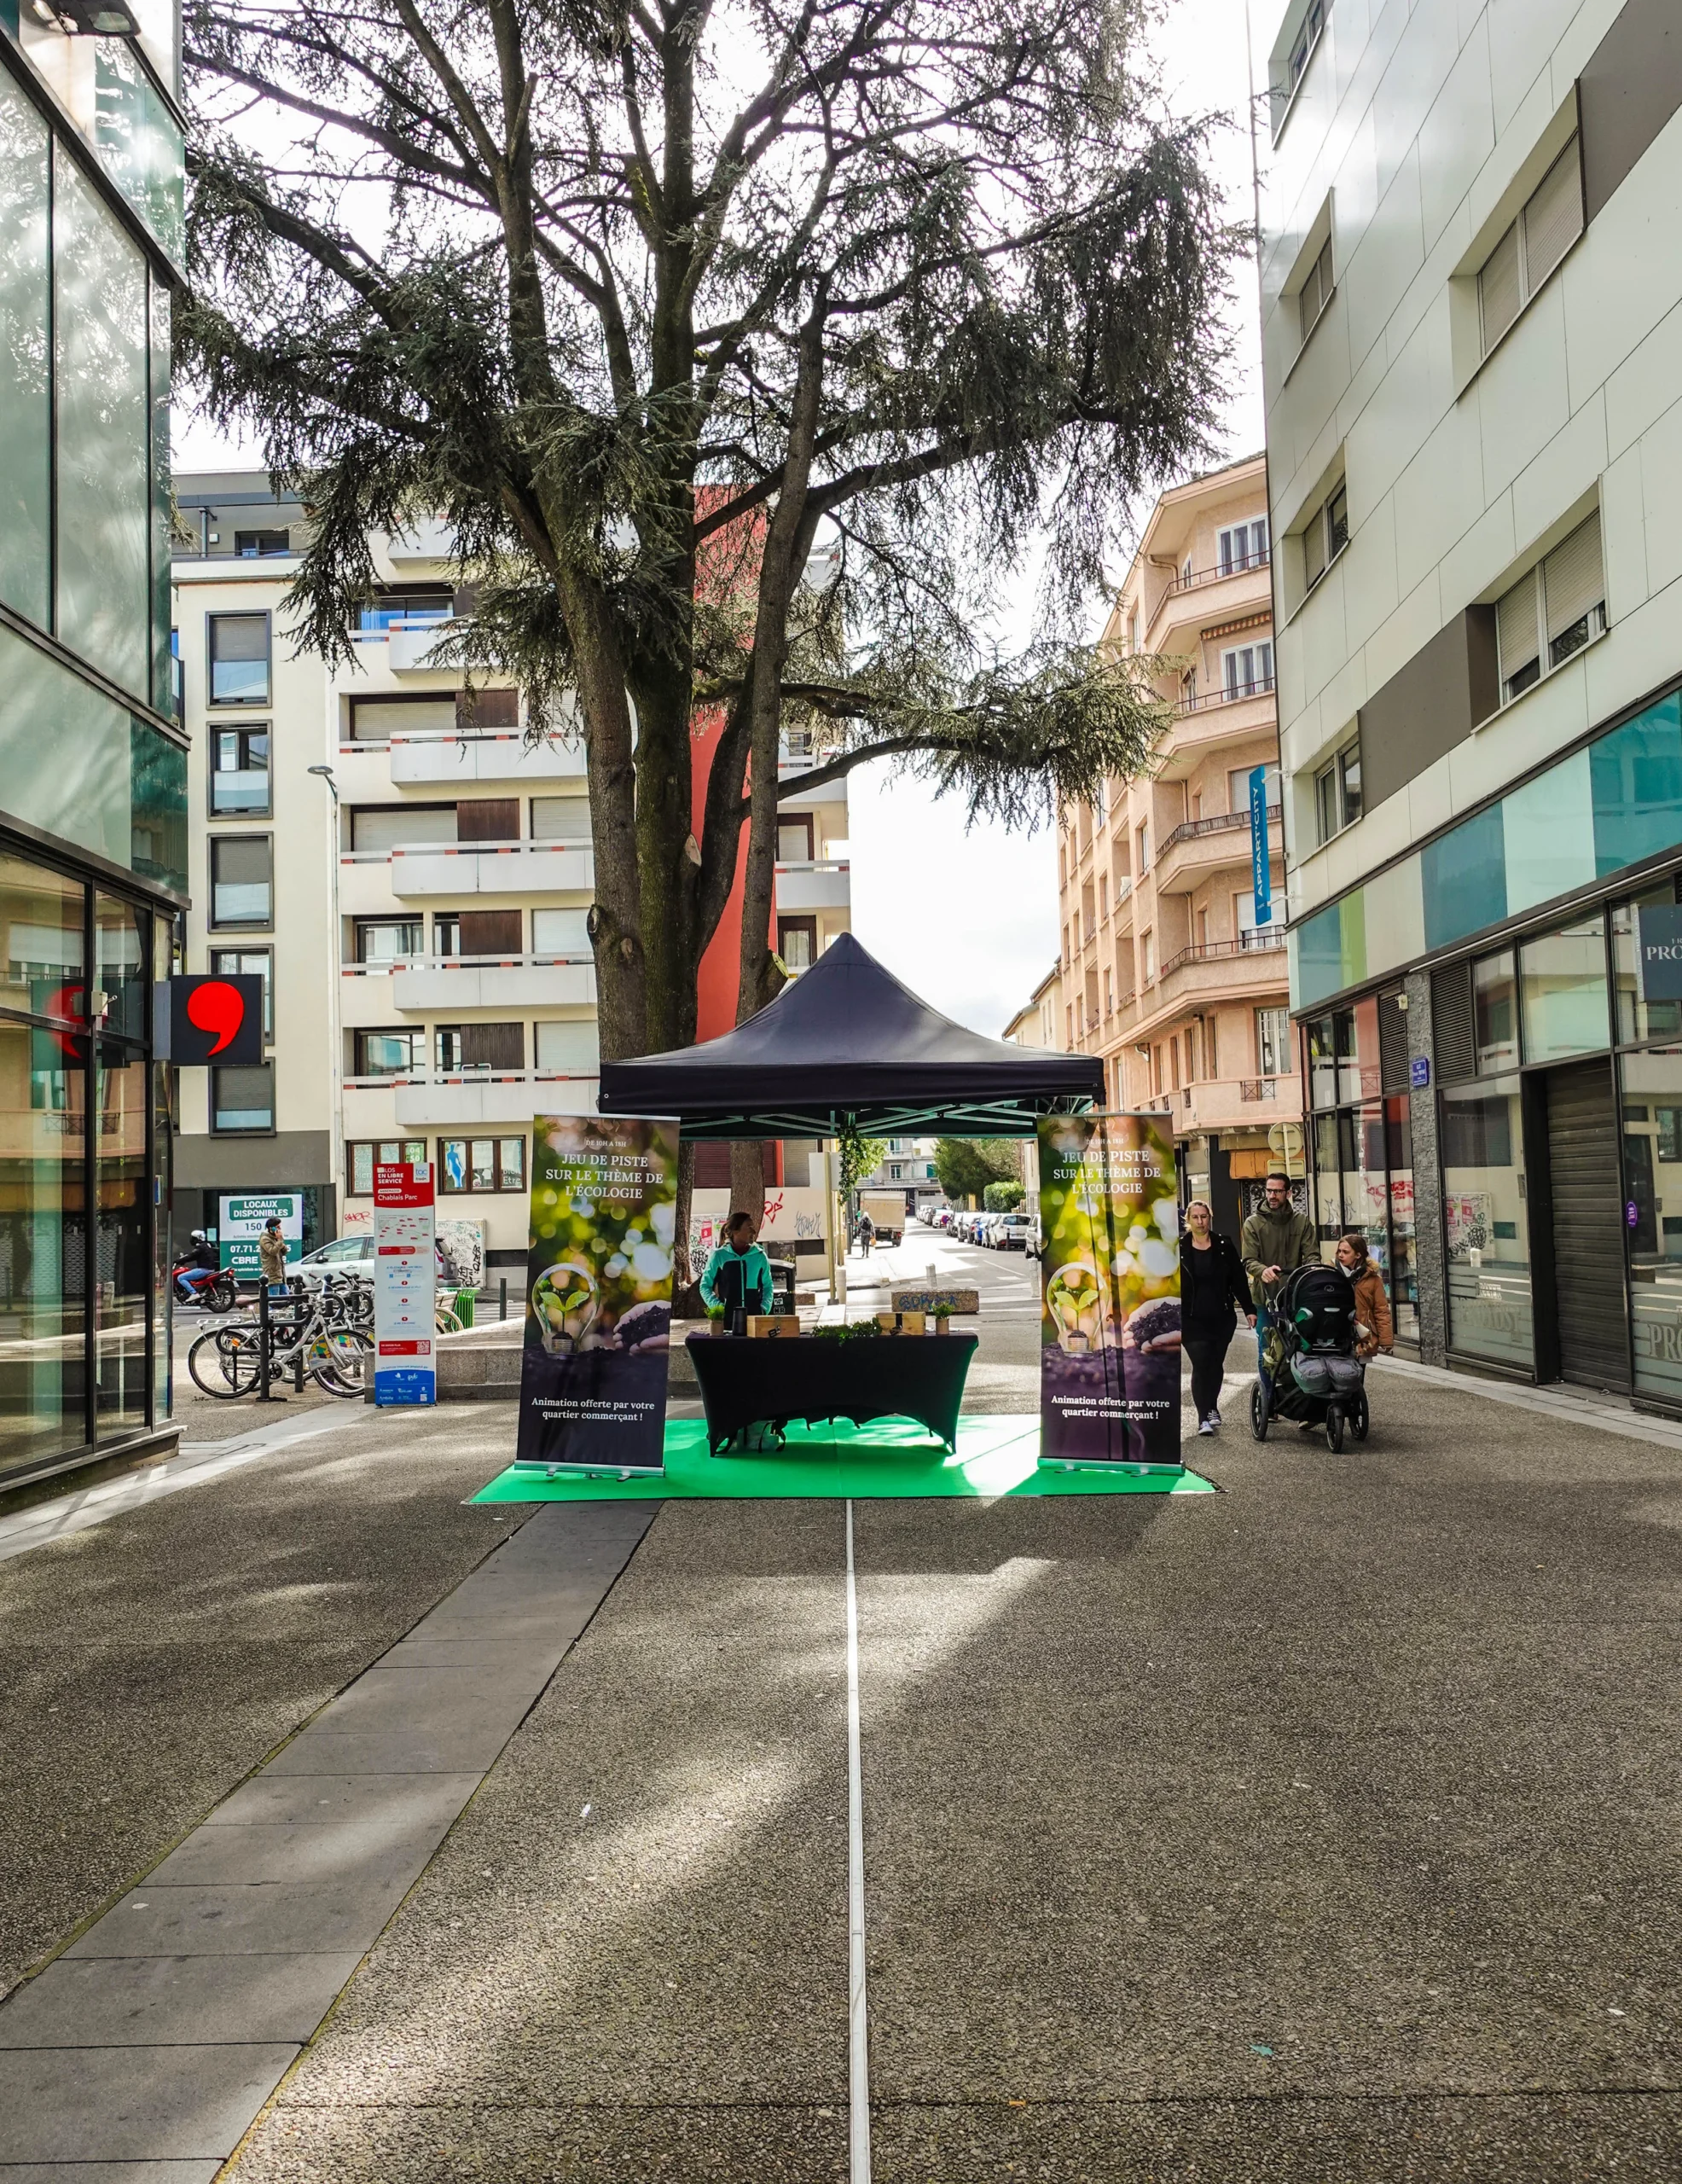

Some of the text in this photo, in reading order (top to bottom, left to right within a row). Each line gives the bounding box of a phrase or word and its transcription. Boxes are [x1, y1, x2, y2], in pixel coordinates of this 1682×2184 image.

[1252, 787, 1263, 897] APPART'CITY
[561, 1153, 648, 1167] JEU DE PISTE
[1063, 1150, 1150, 1164] JEU DE PISTE
[545, 1169, 664, 1184] SUR LE THÈME DE
[1053, 1165, 1161, 1179] SUR LE THÈME DE
[502, 1176, 521, 1184] Etre
[566, 1182, 643, 1199] L'ÉCOLOGIE
[1072, 1181, 1143, 1194] L'ÉCOLOGIE
[243, 1199, 278, 1209] LOCAUX
[233, 1208, 288, 1218] DISPONIBLES
[245, 1223, 262, 1231] 150
[231, 1256, 258, 1264] CBRE
[531, 1397, 655, 1410] Animation offerte par votre
[1051, 1395, 1169, 1409] Animation offerte par votre
[542, 1409, 643, 1422] quartier commerçant !
[1062, 1408, 1099, 1418] quartier
[1099, 1410, 1154, 1420] commerçant
